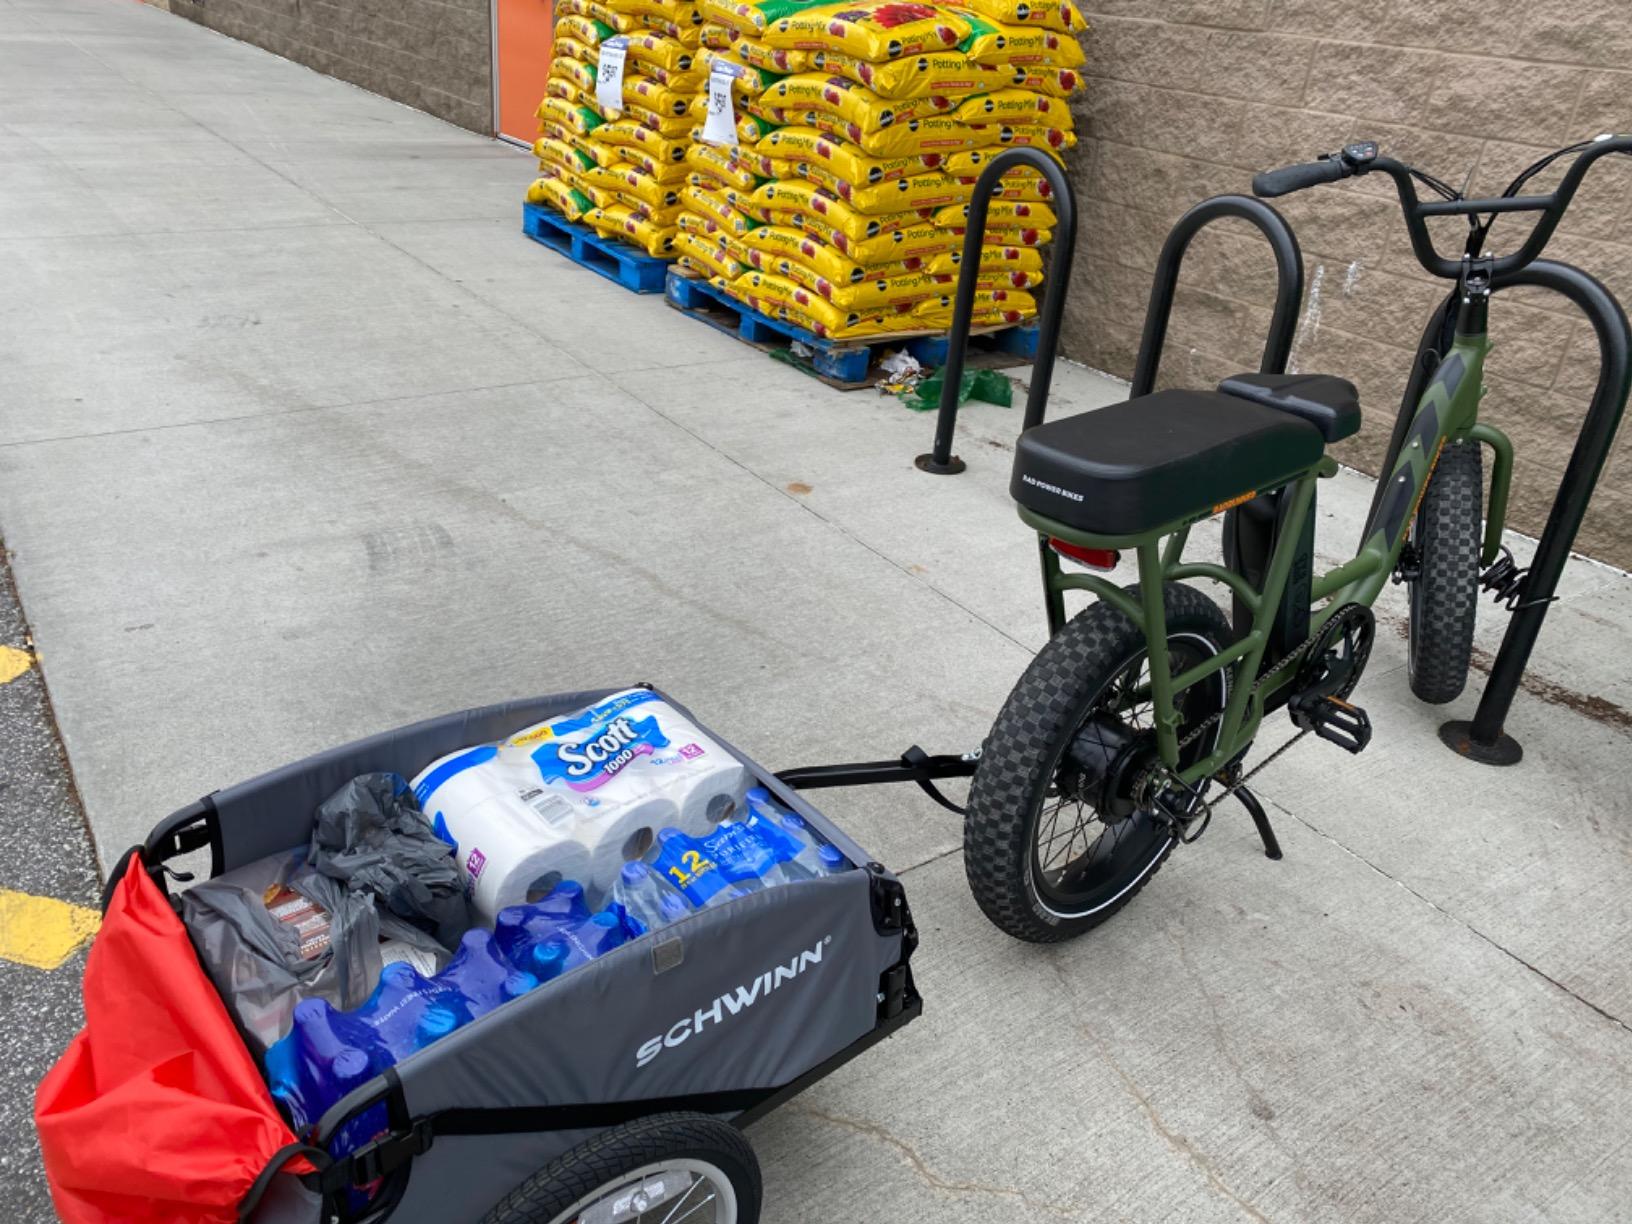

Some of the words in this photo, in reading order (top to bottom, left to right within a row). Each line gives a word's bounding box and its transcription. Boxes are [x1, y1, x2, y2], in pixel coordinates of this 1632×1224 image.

[792, 21, 815, 32] Potting
[902, 32, 926, 44] Potting
[1009, 37, 1034, 47] Potting
[932, 60, 961, 70] Potting
[789, 85, 811, 95] Potting
[893, 99, 917, 111] Potting
[998, 100, 1023, 109] Potting
[923, 120, 951, 129] Potting
[1015, 127, 1036, 136] Potting
[782, 134, 804, 146] Potting
[883, 158, 908, 170] Potting
[912, 177, 941, 189] Potting
[778, 189, 799, 202] Potting
[880, 209, 903, 223] Potting
[770, 231, 789, 245] Potting
[907, 229, 935, 239] Potting
[763, 280, 782, 294] Potting
[891, 278, 918, 288] Potting
[1036, 480, 1062, 495] POWER
[1061, 488, 1085, 502] BIKES
[558, 716, 638, 776] Scott
[604, 749, 634, 774] 1000
[668, 850, 710, 884] 12
[636, 941, 823, 1068] SCHWINN
